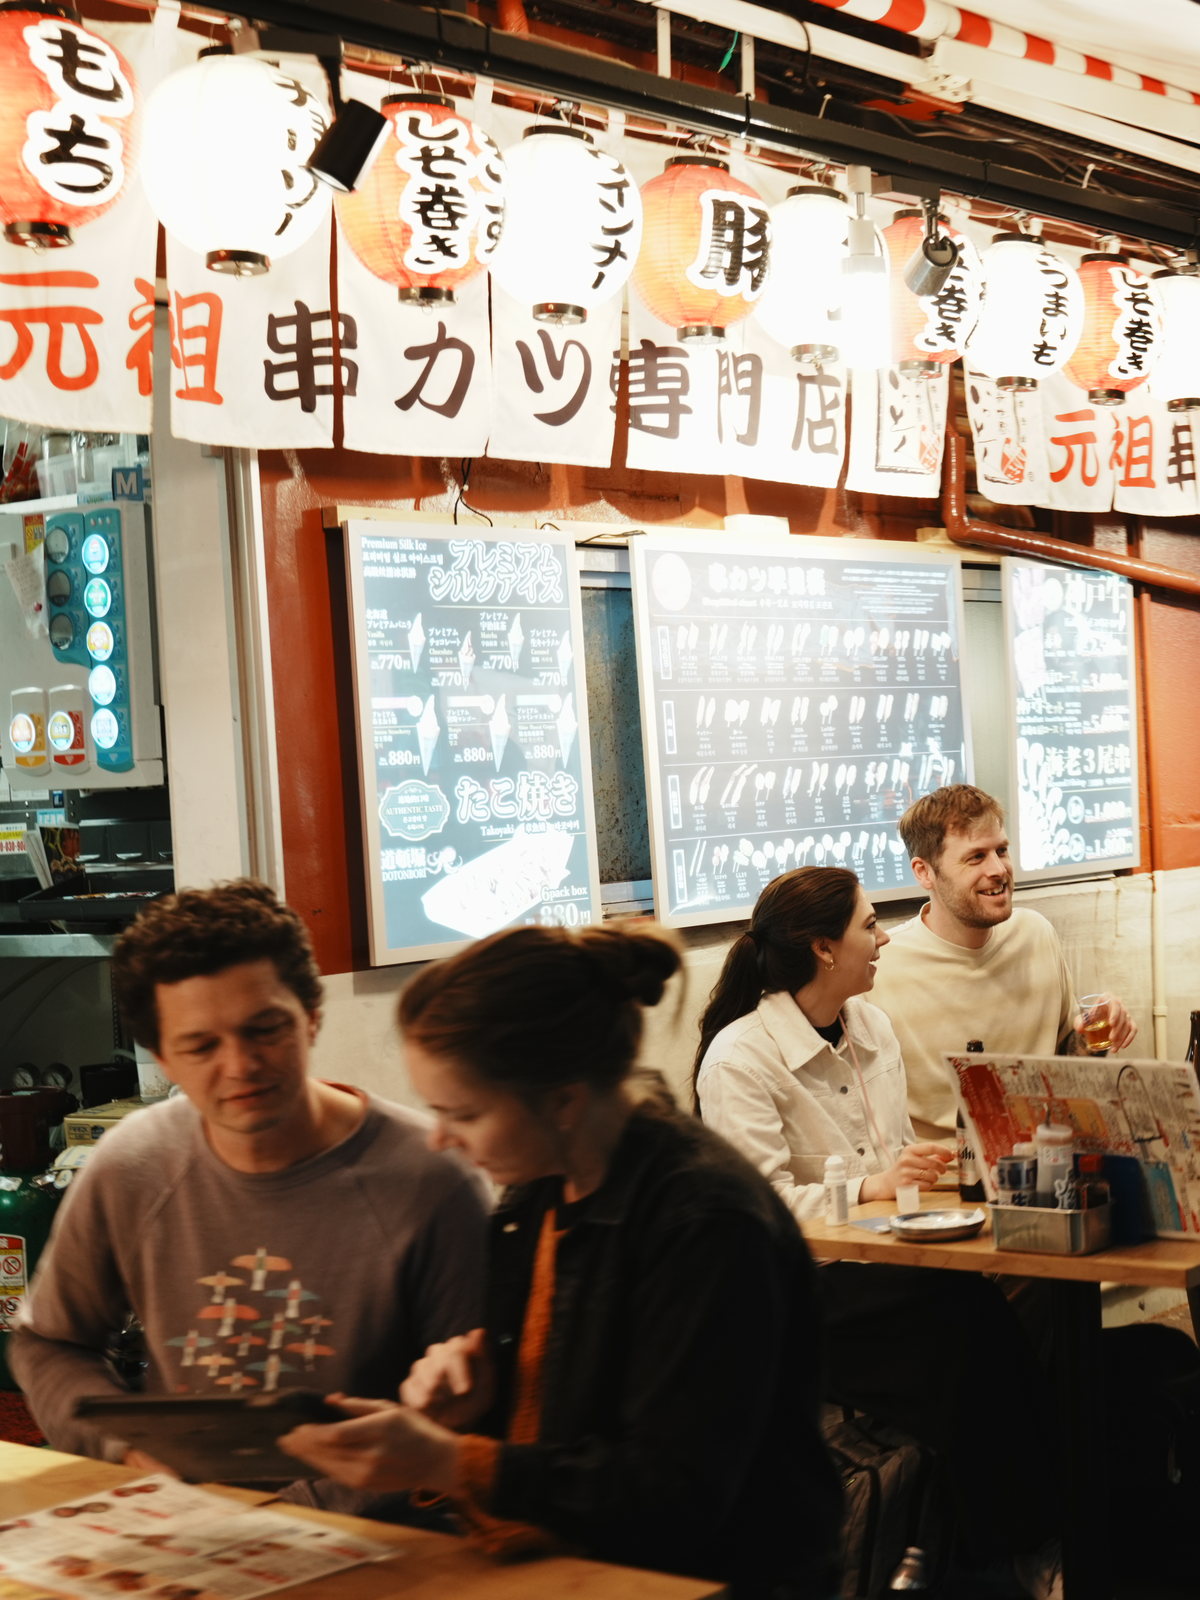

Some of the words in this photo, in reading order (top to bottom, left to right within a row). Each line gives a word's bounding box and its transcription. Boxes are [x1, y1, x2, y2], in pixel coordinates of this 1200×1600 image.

[41, 27, 126, 195] もち
[1118, 270, 1154, 375] しそ巻き
[362, 537, 397, 549] Premium
[399, 539, 414, 550] Silk
[415, 540, 427, 551] Ice
[449, 539, 562, 577] プレミアム
[428, 566, 564, 604] シルクアイス
[424, 805, 443, 813] TASTE
[455, 771, 579, 824] たこ焼き
[480, 823, 515, 837] Takoyaki
[382, 868, 427, 882] DOTONBORI
[571, 885, 588, 896] box
